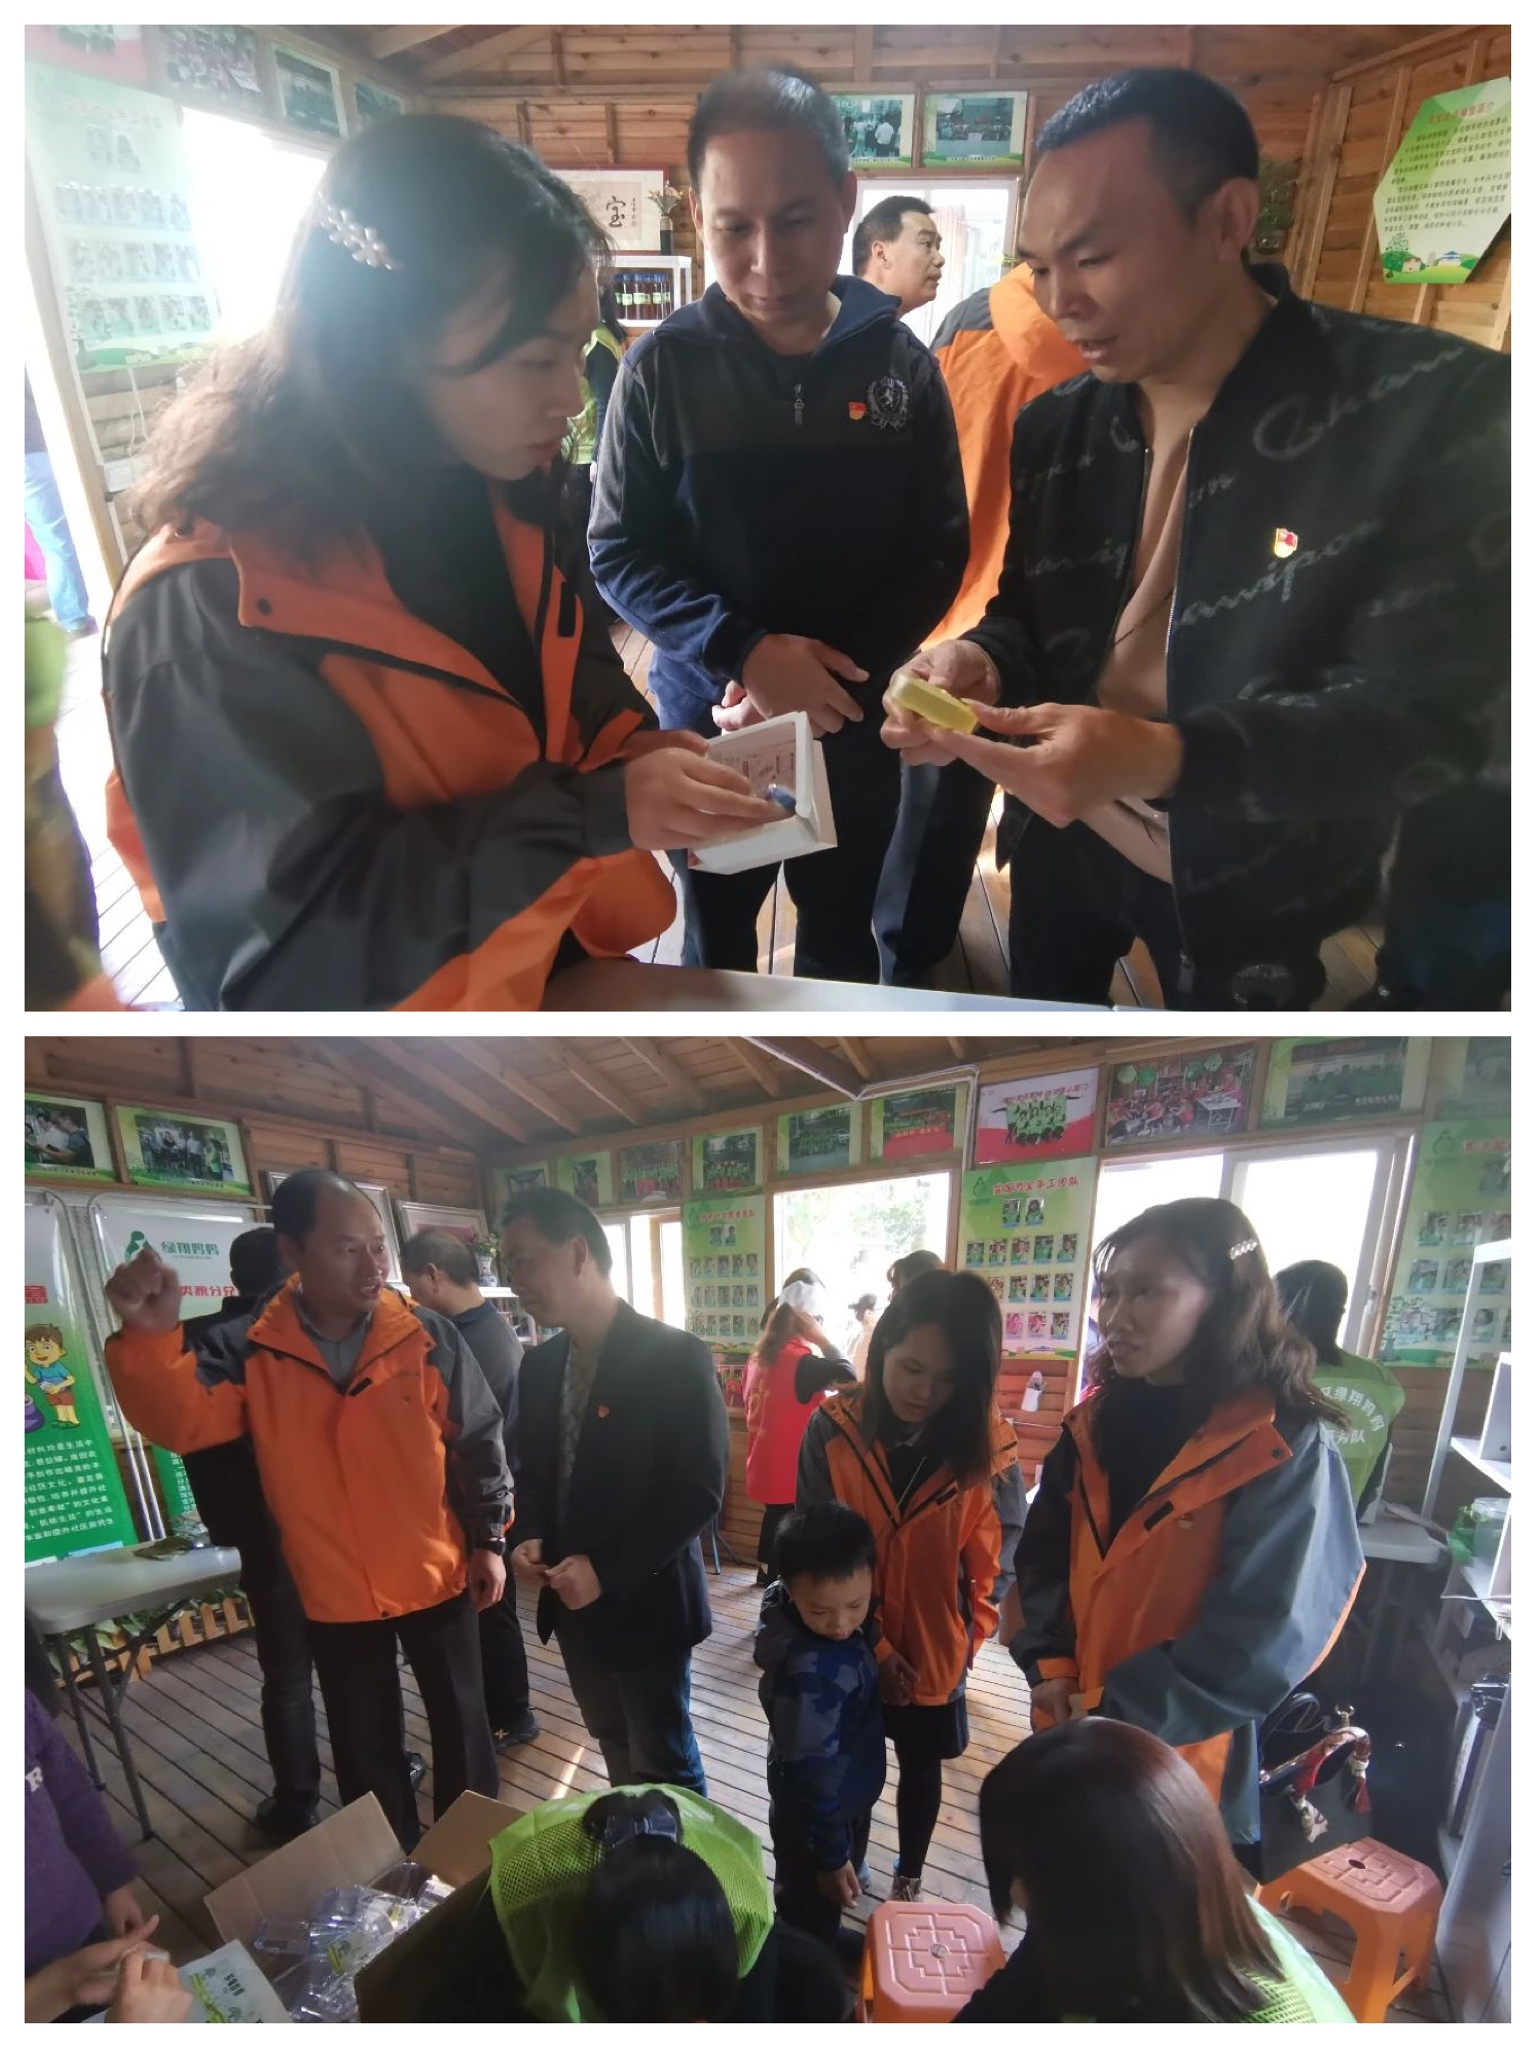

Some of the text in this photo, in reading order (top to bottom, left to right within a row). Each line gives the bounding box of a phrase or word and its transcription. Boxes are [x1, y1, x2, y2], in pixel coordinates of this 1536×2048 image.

[161, 1241, 220, 1255] 绿翔妈妈
[25, 1767, 43, 1792] R
